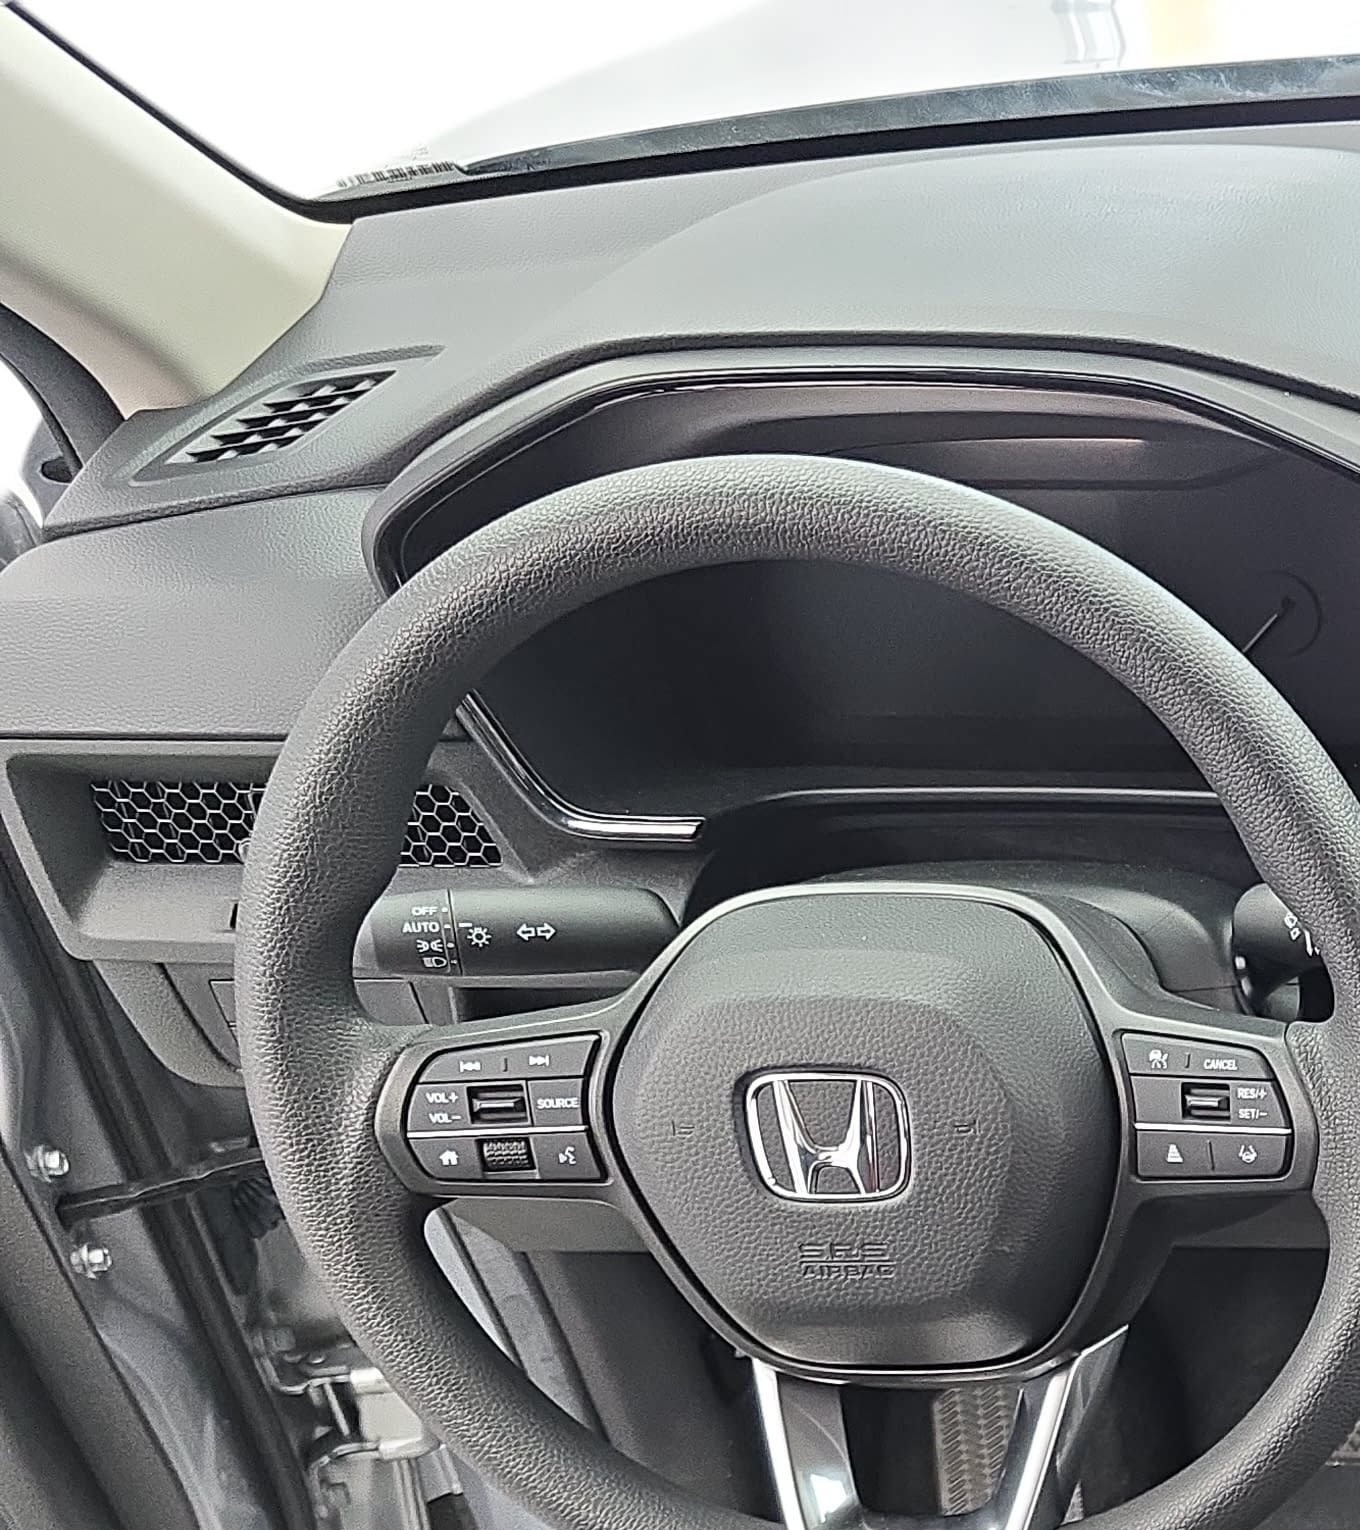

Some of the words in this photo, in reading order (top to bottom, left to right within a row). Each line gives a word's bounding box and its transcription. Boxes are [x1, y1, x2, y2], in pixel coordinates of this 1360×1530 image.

[411, 905, 438, 917] OFF
[402, 920, 440, 934] AUTO
[1203, 1059, 1238, 1071] CANCEL
[536, 1096, 580, 1110] SOURCE
[801, 1263, 897, 1280] AIRBAG
